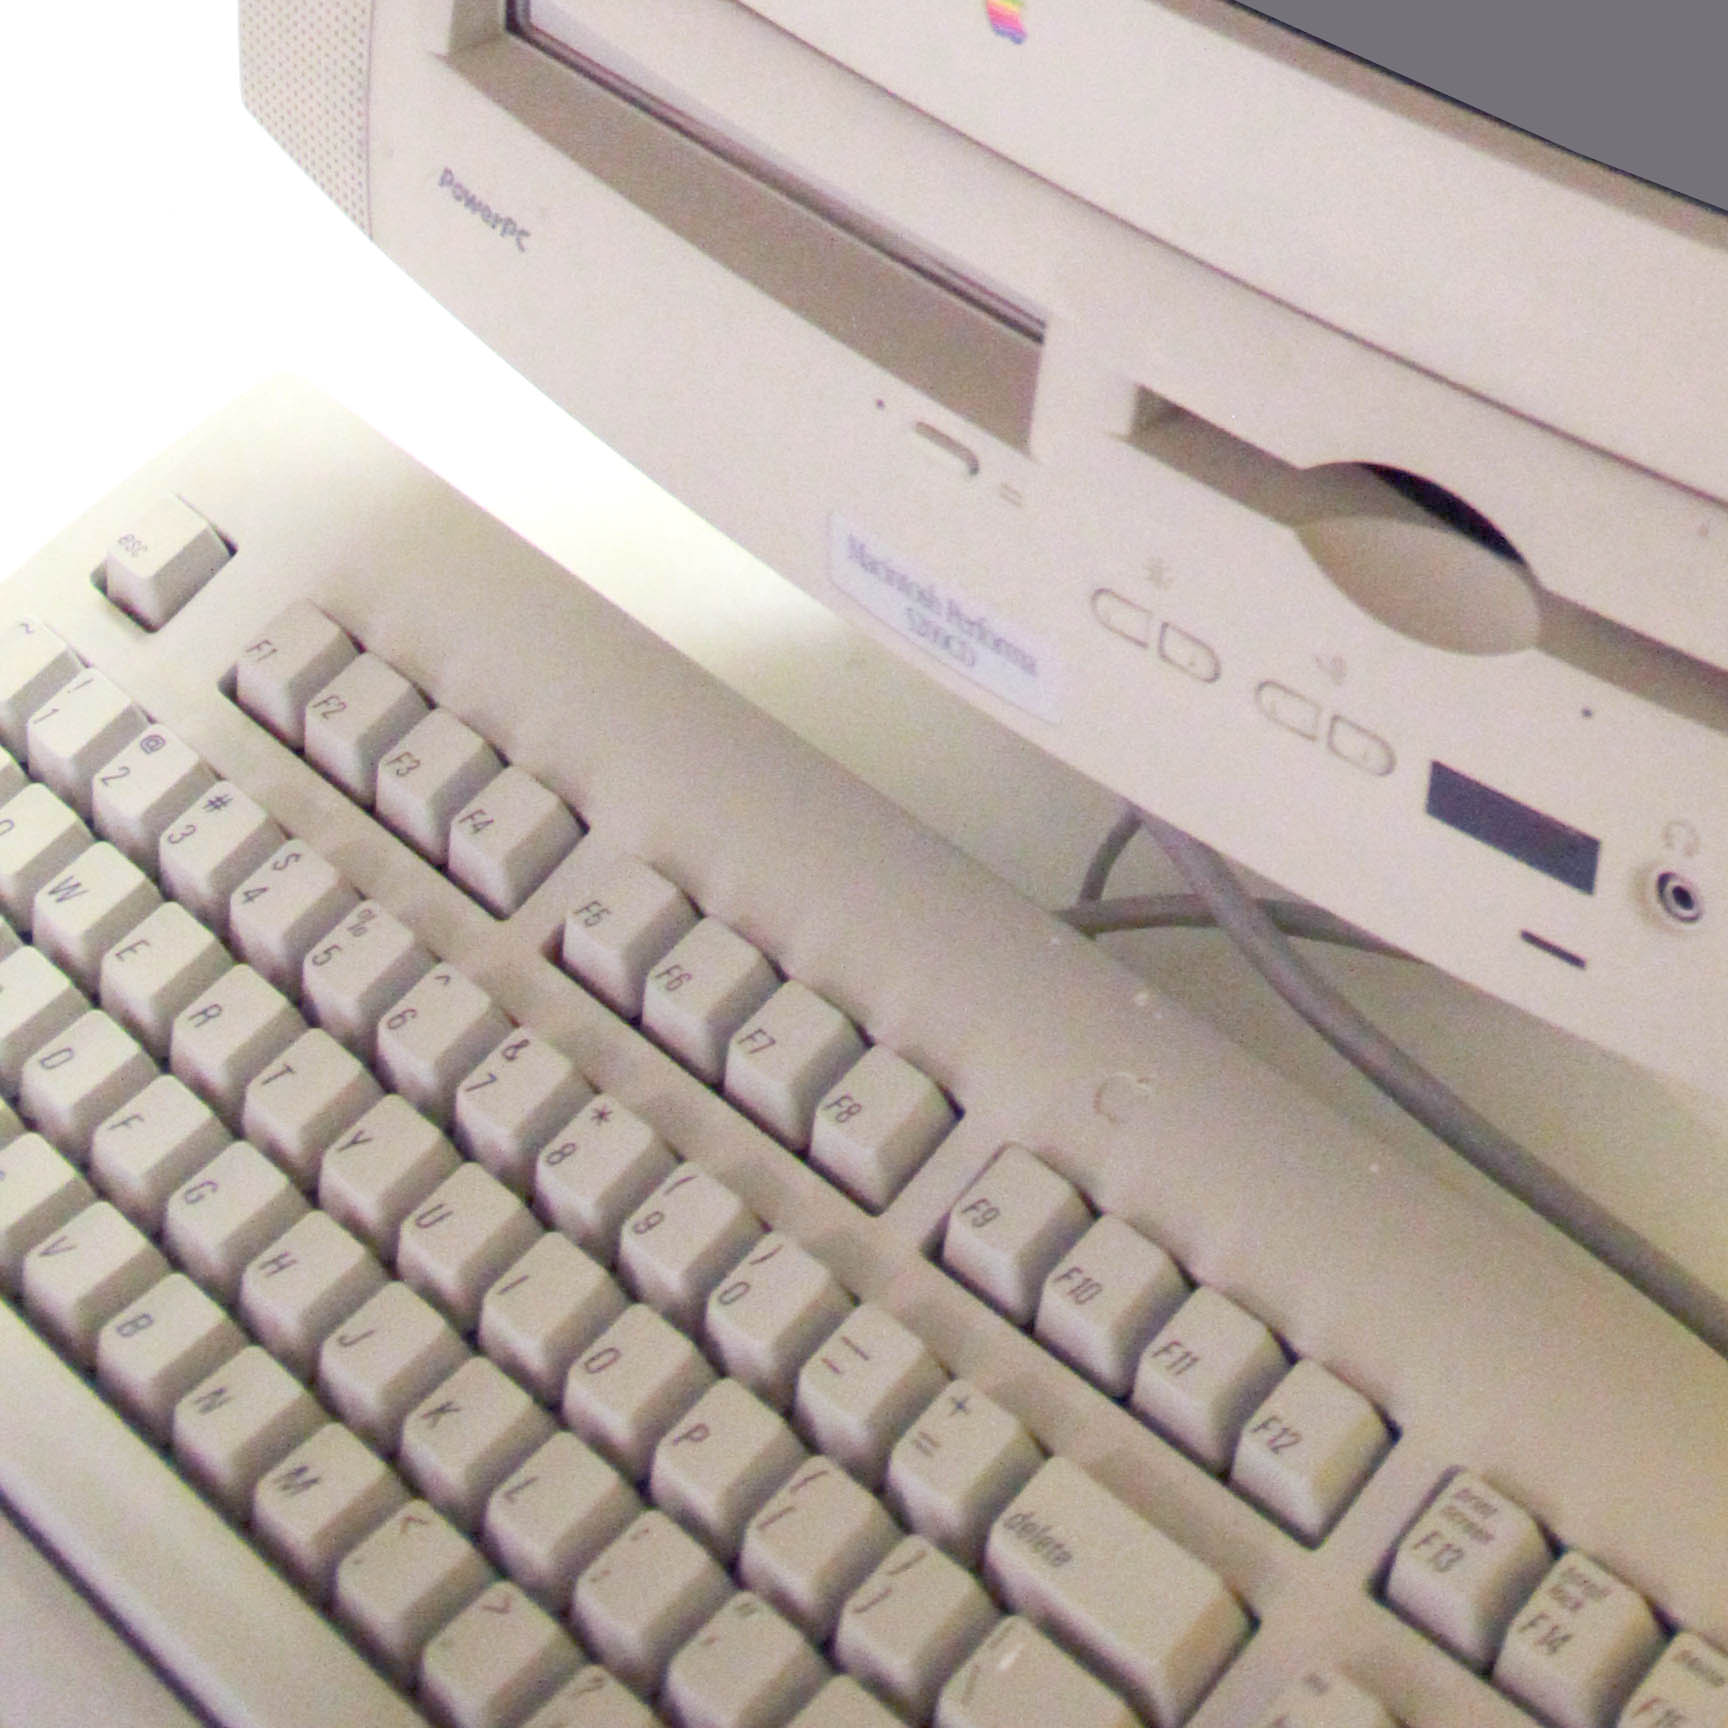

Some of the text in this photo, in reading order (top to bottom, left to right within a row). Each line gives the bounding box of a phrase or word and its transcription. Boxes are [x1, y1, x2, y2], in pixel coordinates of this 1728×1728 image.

[438, 167, 531, 252] PowerPC
[245, 639, 278, 662] F1
[33, 707, 60, 725] 1
[312, 694, 348, 721] F2
[139, 734, 166, 755] @
[101, 766, 130, 787] 2
[386, 751, 421, 779] F3
[202, 794, 233, 813] #
[168, 824, 197, 845] 3
[459, 807, 496, 836] F4
[48, 874, 88, 904] W
[241, 886, 269, 905] 4
[348, 907, 376, 938] %
[574, 900, 612, 928] F5
[115, 939, 151, 962] E
[312, 944, 342, 968] 5
[655, 963, 694, 993] F6
[187, 1002, 223, 1029] R
[386, 1007, 417, 1031] 6
[501, 1038, 532, 1062] &
[737, 1028, 778, 1055] F7
[261, 1063, 296, 1086] T
[464, 1071, 498, 1093] 7
[109, 1113, 145, 1131] F
[826, 1094, 864, 1125] F8
[337, 1129, 373, 1152] Y
[545, 1142, 577, 1167] 8
[184, 1179, 219, 1205] G
[414, 1202, 453, 1230] U
[631, 1210, 665, 1235] 9
[962, 1197, 1002, 1230] F9
[40, 1235, 78, 1258] V
[259, 1251, 298, 1278] H
[1053, 1266, 1103, 1306] F10
[116, 1312, 155, 1338] B
[338, 1328, 376, 1349] J
[1152, 1340, 1200, 1376] F11
[193, 1385, 231, 1414] N
[951, 1396, 970, 1417] +
[420, 1400, 461, 1428] K
[672, 1421, 711, 1446] P
[1252, 1414, 1301, 1455] F12
[272, 1464, 321, 1497] M
[504, 1475, 539, 1504] L
[1003, 1511, 1073, 1569] delete
